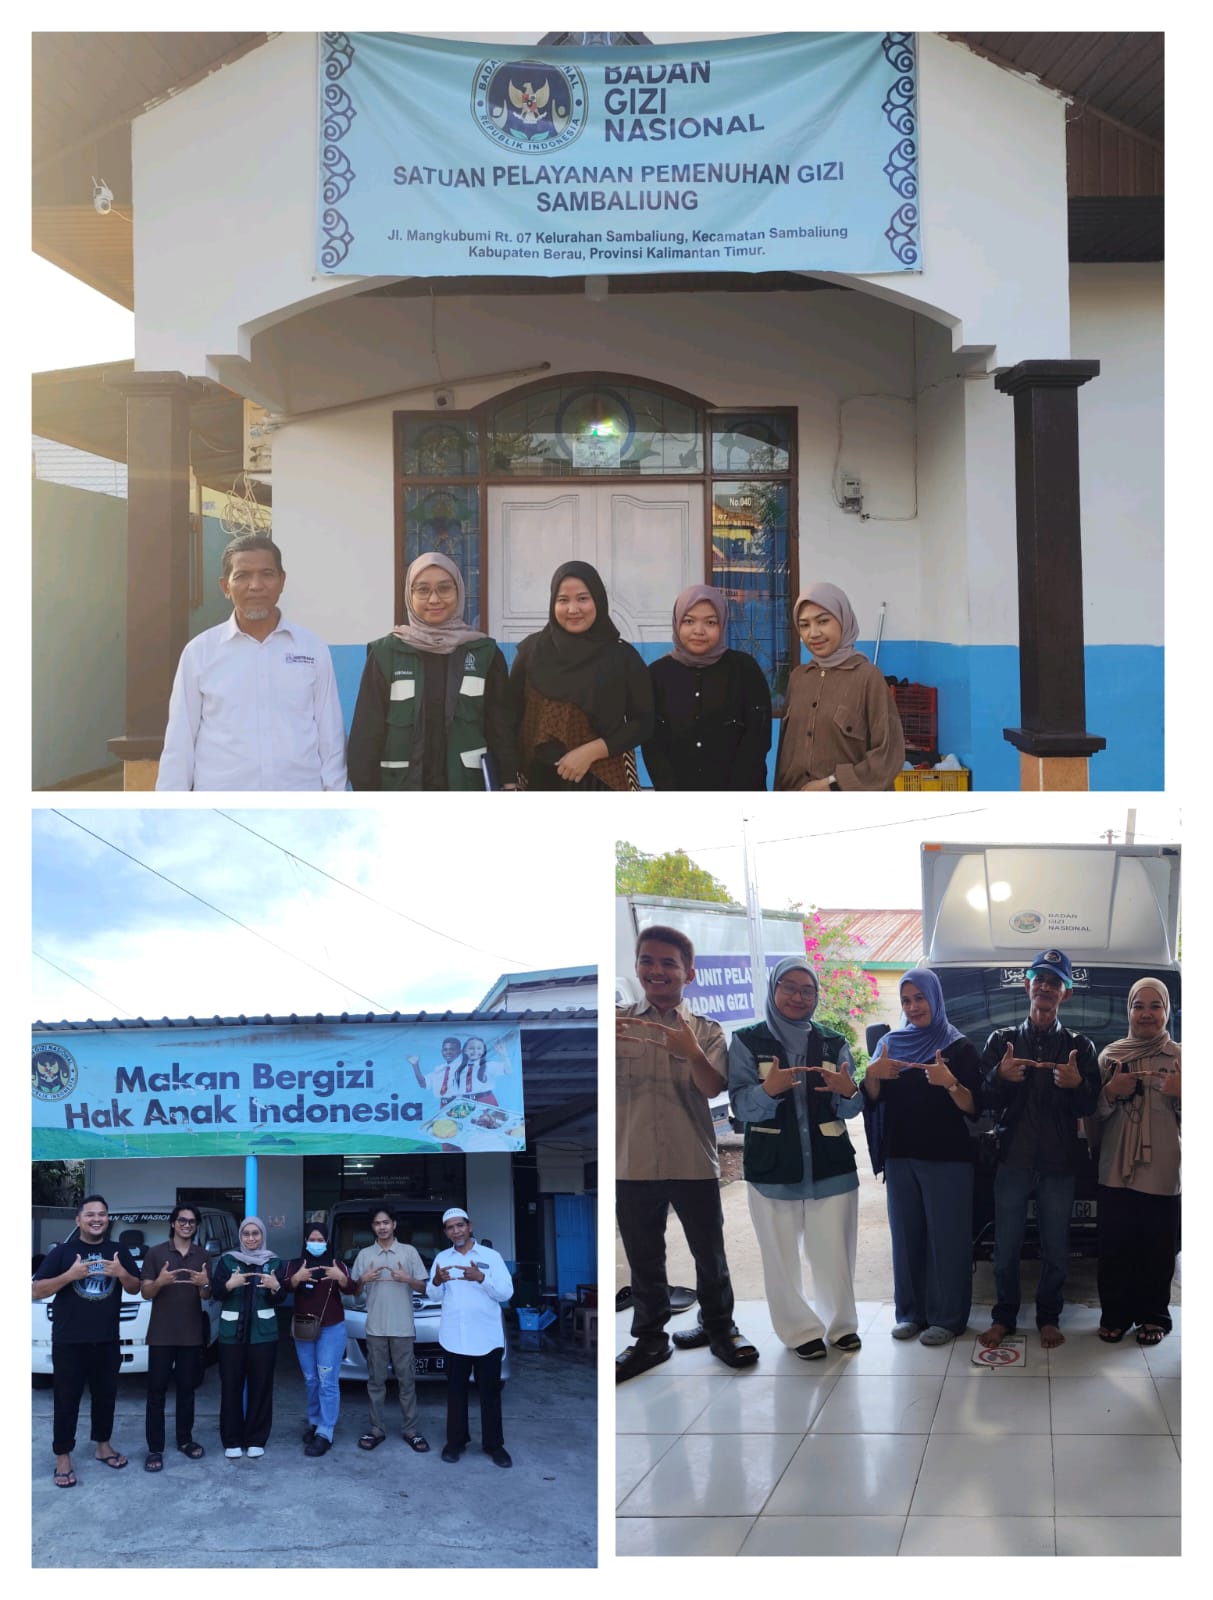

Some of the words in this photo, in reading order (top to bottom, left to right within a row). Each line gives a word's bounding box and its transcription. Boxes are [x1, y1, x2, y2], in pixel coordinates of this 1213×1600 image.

[479, 60, 502, 91] BADA
[604, 88, 667, 115] GIZI
[480, 115, 523, 150] REPUBLIK
[528, 118, 580, 150] INDONESIA
[605, 113, 765, 142] NASIONAL
[393, 166, 485, 188] SATUAN
[493, 165, 632, 186] PELAYANAN
[641, 163, 790, 184] PEMENUHAN
[797, 162, 844, 183] GIZI
[537, 190, 698, 212] SAMBALIUNG
[387, 229, 402, 241] Jl.
[407, 229, 491, 244] Mangkubumi
[495, 231, 513, 243] Rt.
[516, 232, 531, 243] 07
[536, 230, 602, 244] Kelurahan
[606, 230, 688, 245] Sambaliung,
[692, 229, 765, 242] Kecamatan
[769, 225, 848, 240] Sambaliung
[468, 245, 539, 260] Kabupaten
[543, 248, 586, 261] Berau,
[590, 246, 642, 259] Provinsi
[647, 246, 720, 259] Kalimantan
[724, 245, 766, 258] Timur.
[694, 967, 723, 987] UNIT
[727, 992, 749, 1011] GIZI
[115, 1062, 240, 1093] Makan
[253, 1060, 374, 1098] Bergizi
[64, 1098, 134, 1129] Hak
[143, 1095, 238, 1126] Anak
[249, 1093, 423, 1123] Indonesia
